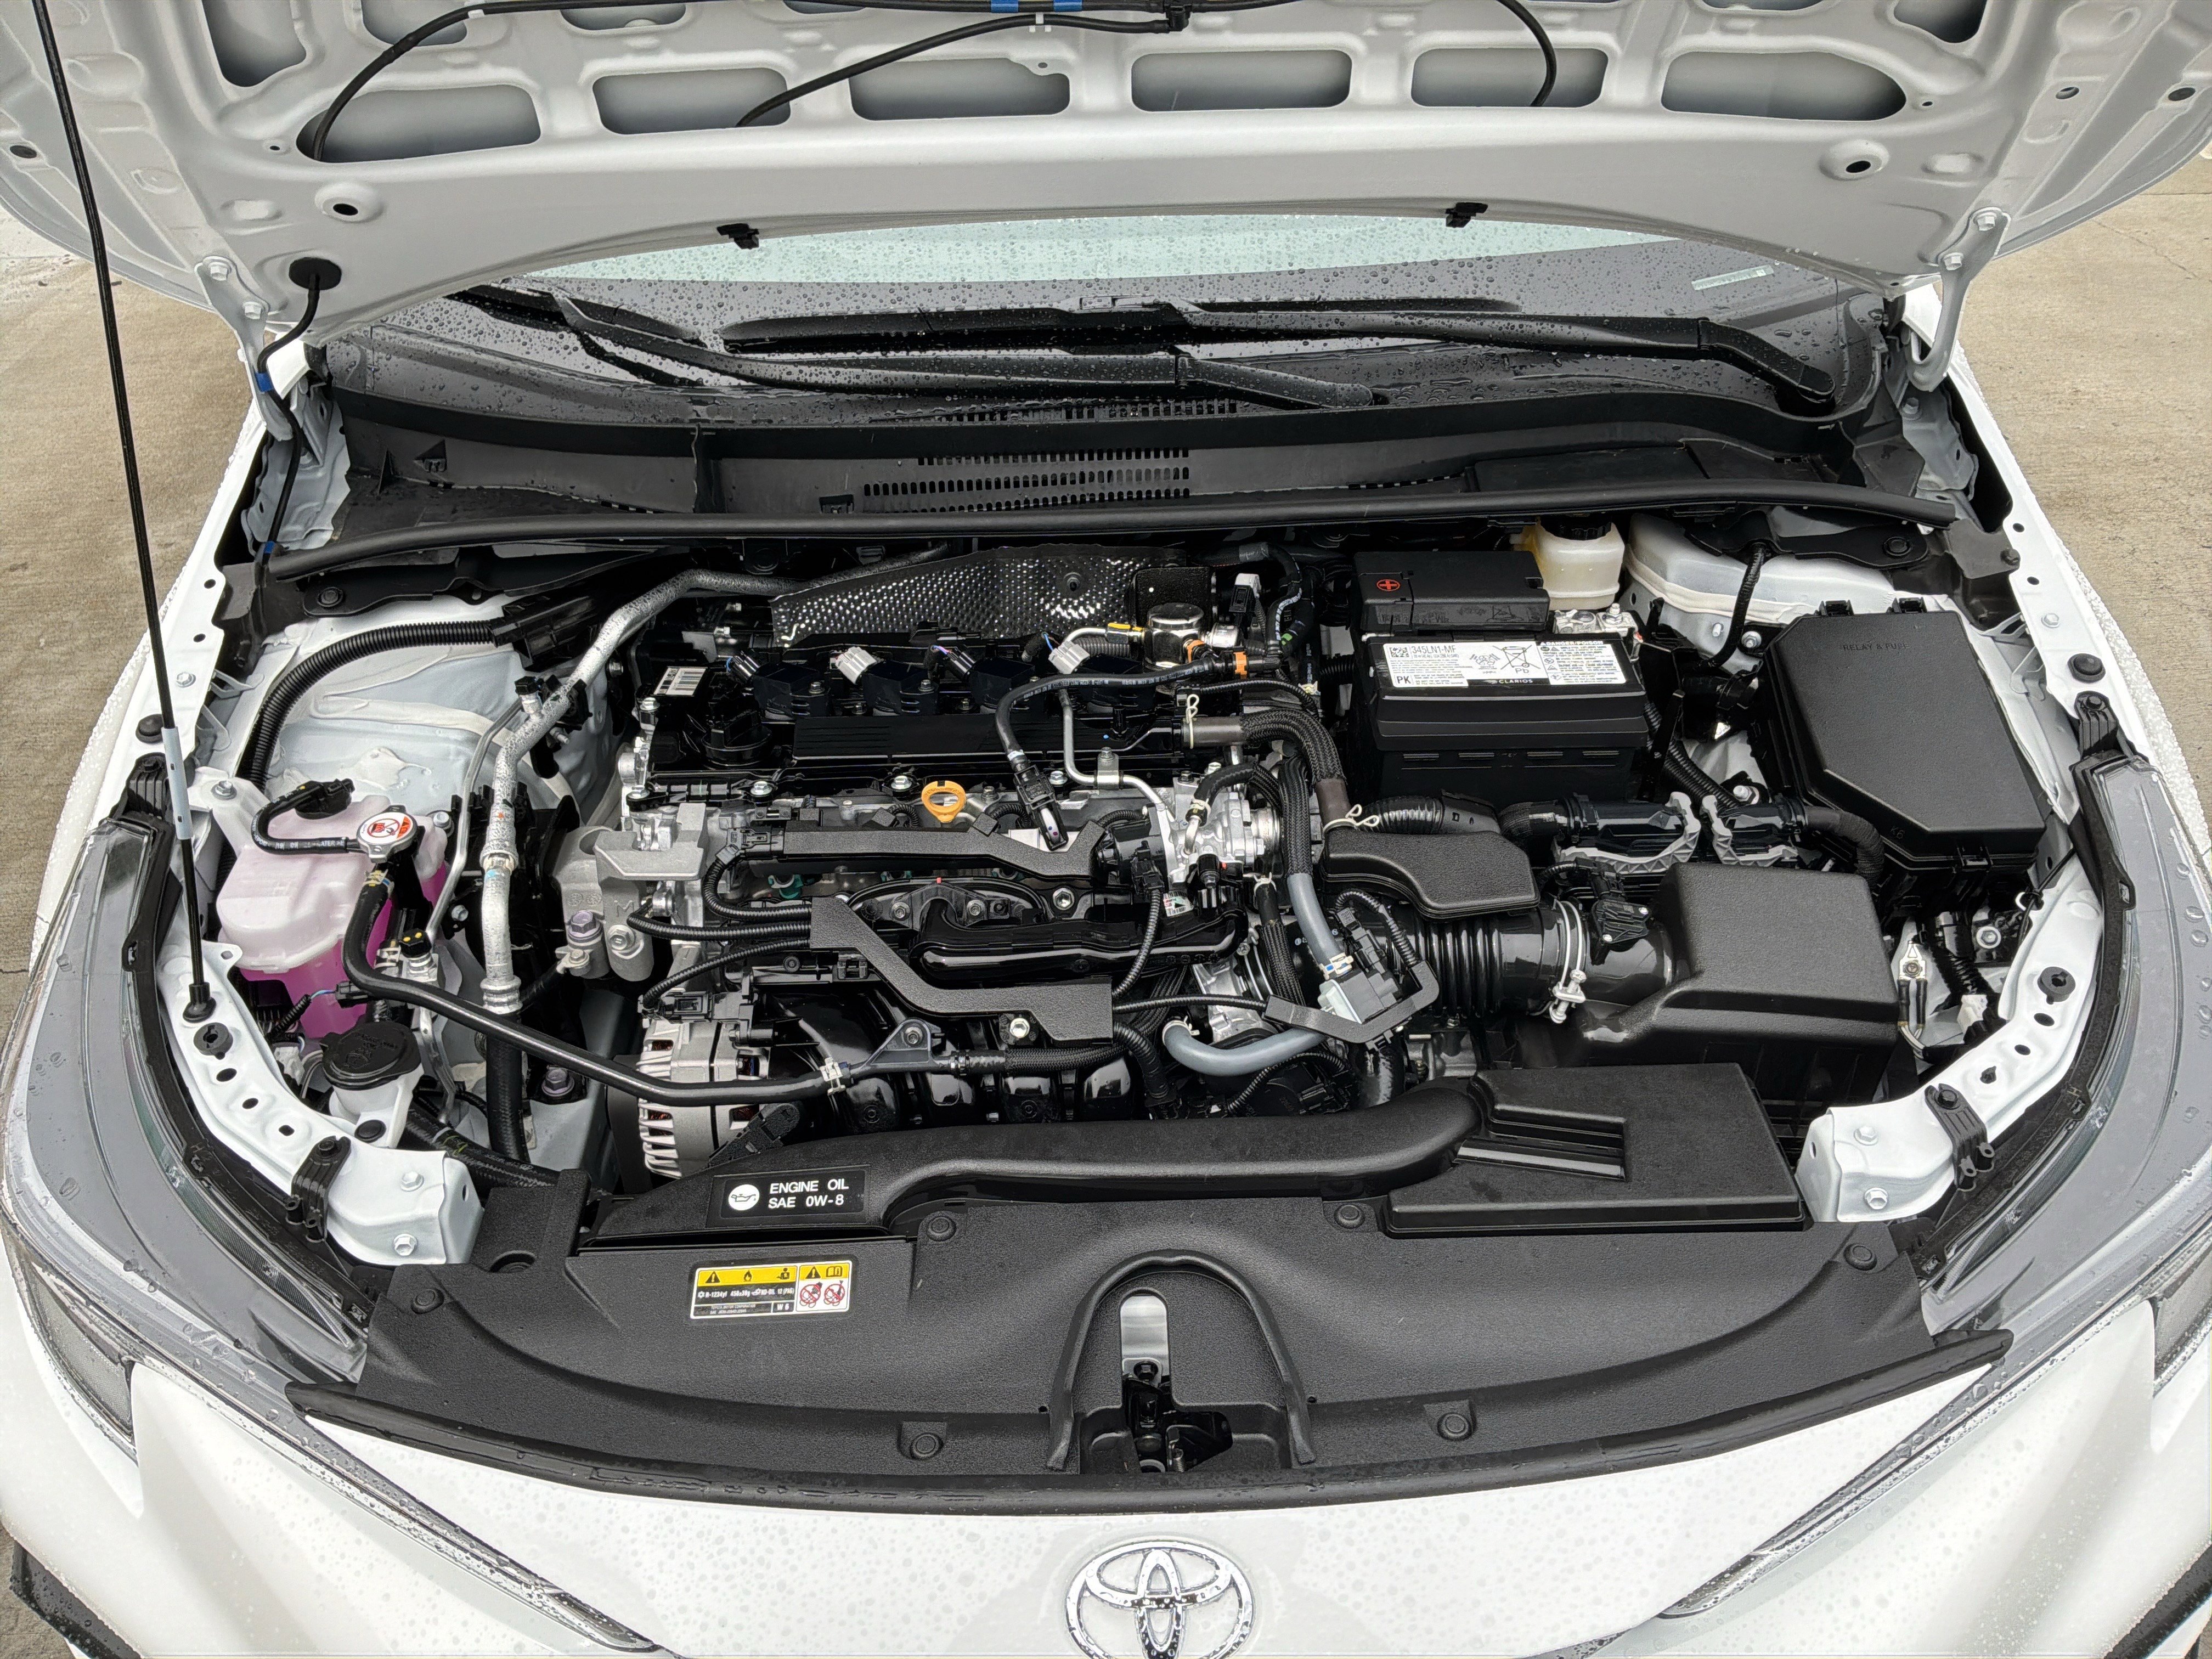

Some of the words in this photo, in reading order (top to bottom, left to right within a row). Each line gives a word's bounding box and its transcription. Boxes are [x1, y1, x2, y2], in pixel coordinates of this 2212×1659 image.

[770, 1180, 819, 1194] ENGINE
[827, 1178, 849, 1190] OIL
[768, 1197, 796, 1209] SAE
[805, 1194, 844, 1207] 0W-8
